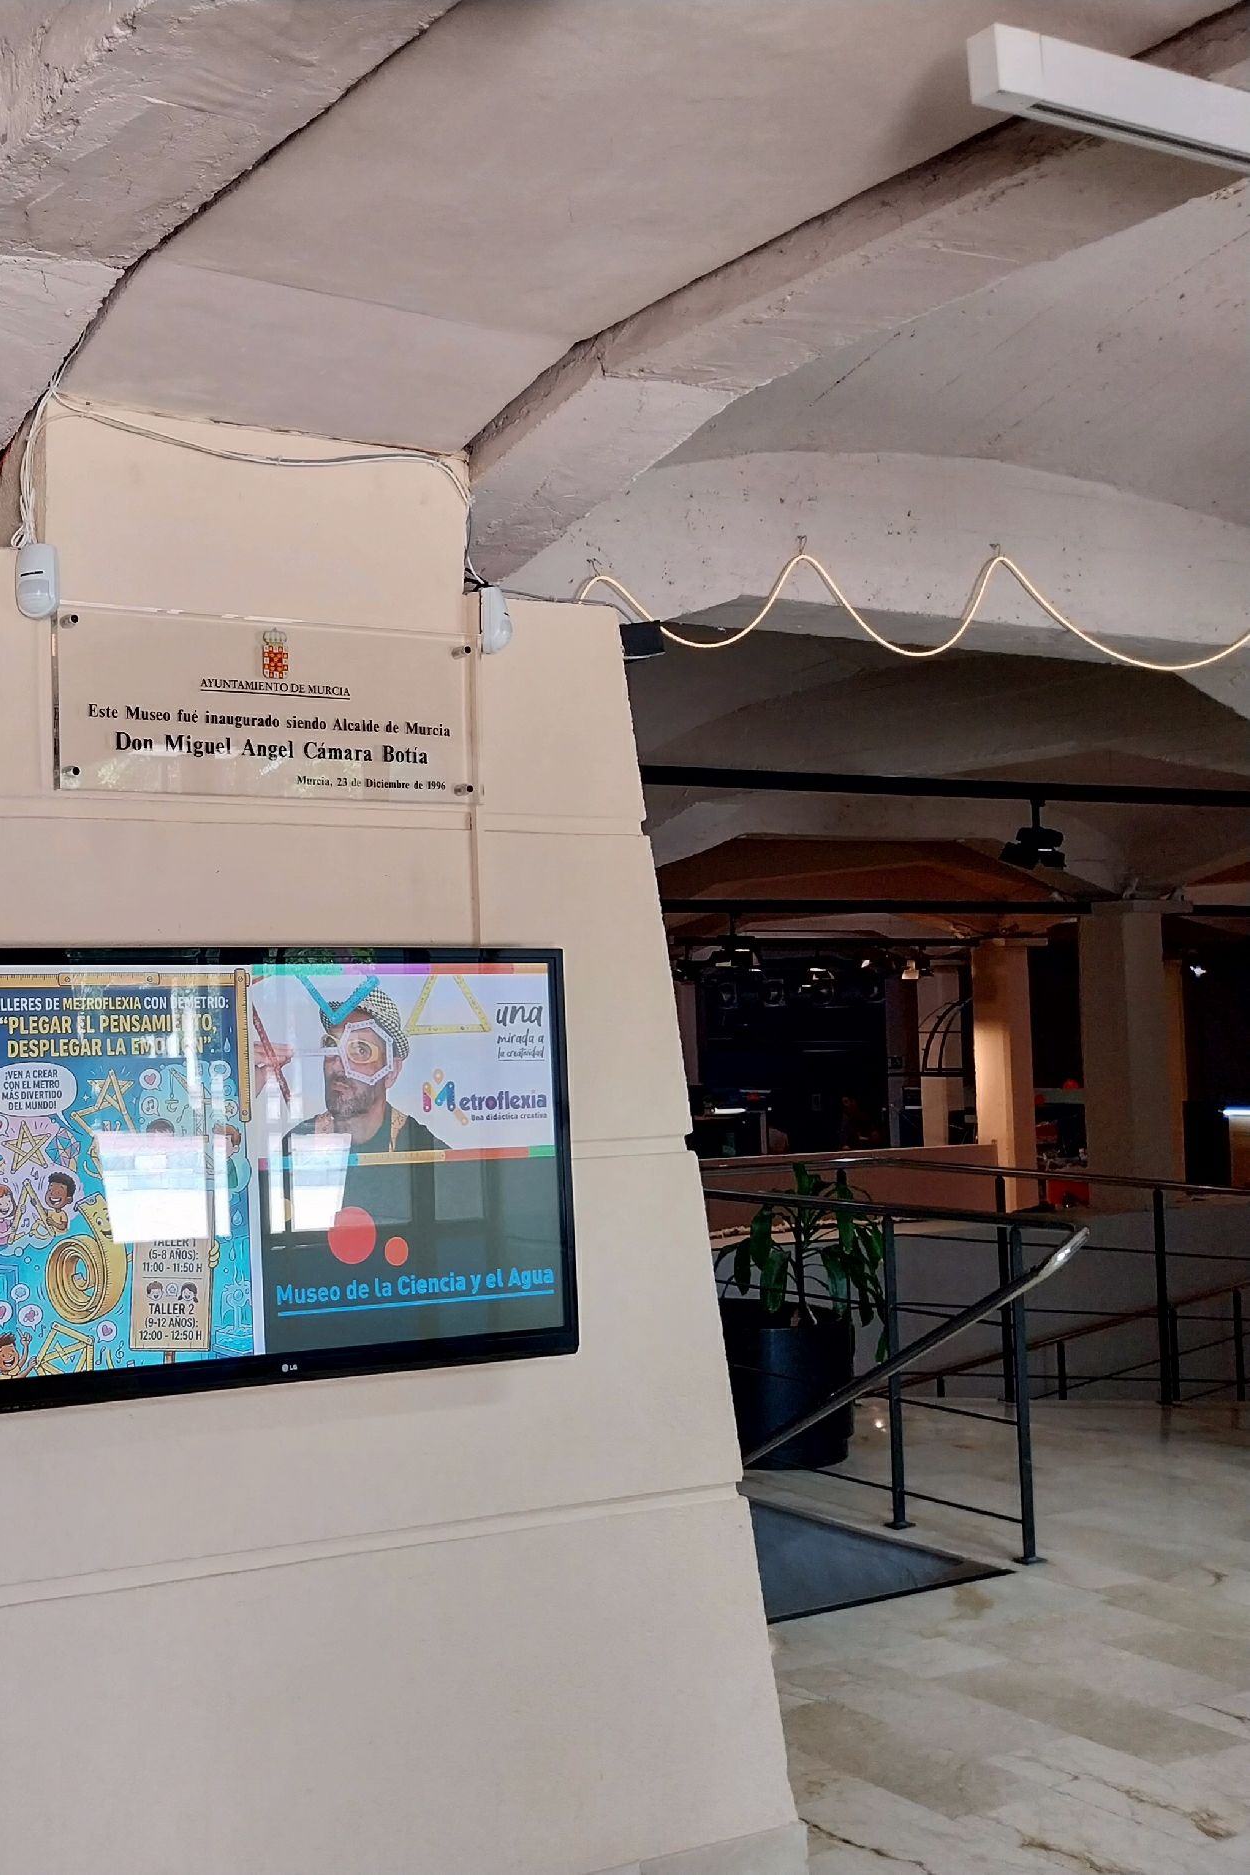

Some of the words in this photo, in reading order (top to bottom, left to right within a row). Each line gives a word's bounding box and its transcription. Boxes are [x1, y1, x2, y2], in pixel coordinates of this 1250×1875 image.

[200, 678, 288, 693] AYUNTAMIENTO
[290, 683, 305, 693] DE
[308, 685, 351, 697] MURCIA
[88, 703, 118, 719] Este
[126, 705, 171, 721] Museo
[177, 709, 199, 723] fué
[205, 711, 279, 728] inaugurado
[286, 716, 327, 730] siendo
[332, 718, 380, 733] Alcalde
[385, 720, 399, 733] de
[405, 722, 451, 737] Murcia
[115, 731, 153, 751] Don
[164, 734, 231, 758] Miguel
[241, 739, 293, 759] Angel
[303, 741, 373, 762] Cámara
[383, 745, 428, 764] Botía
[297, 775, 333, 787] Murcia,
[337, 778, 348, 787] 23
[351, 778, 362, 787] de
[366, 778, 410, 789] Diciembre
[414, 781, 424, 789] de
[427, 781, 446, 790] 1996
[45, 998, 60, 1010] DE
[62, 997, 142, 1011] METROFLEXIA
[144, 996, 167, 1009] CON
[496, 1004, 543, 1027] una
[77, 1015, 95, 1033] EL
[99, 1013, 217, 1034] PENSAMIETO,
[497, 1028, 534, 1046] mirada
[538, 1034, 545, 1044] a
[7, 1038, 102, 1058] DESPLEGAR
[106, 1037, 126, 1055] LA
[5, 1070, 23, 1080] ¡VEN
[25, 1070, 31, 1078] A
[32, 1069, 58, 1078] CREAR
[3, 1081, 20, 1090] CON
[22, 1081, 30, 1089] EL
[33, 1080, 60, 1088] METRO
[2, 1089, 19, 1100] MÁS
[21, 1090, 63, 1099] DIVERTIDO
[8, 1101, 22, 1110] DEL
[25, 1101, 57, 1110] MUNDO!
[486, 1112, 518, 1120] didáctica
[149, 1249, 167, 1259] (5-8
[169, 1247, 199, 1260] AÑOS):
[143, 1262, 164, 1272] 11:00
[173, 1263, 194, 1273] 11:50
[196, 1263, 203, 1273] H
[276, 1284, 340, 1306] Museo
[346, 1279, 370, 1300] de
[375, 1277, 392, 1297] la
[398, 1271, 466, 1295] Ciencia
[470, 1273, 481, 1294] y
[486, 1268, 503, 1288] el
[508, 1267, 554, 1290] Agua
[149, 1303, 185, 1315] TALLER
[188, 1303, 195, 1314] 2
[145, 1317, 166, 1328] (9-12
[168, 1315, 199, 1328] AÑOS):
[139, 1330, 162, 1341] 12:00
[171, 1330, 194, 1341] 12:50
[196, 1330, 202, 1341] H
